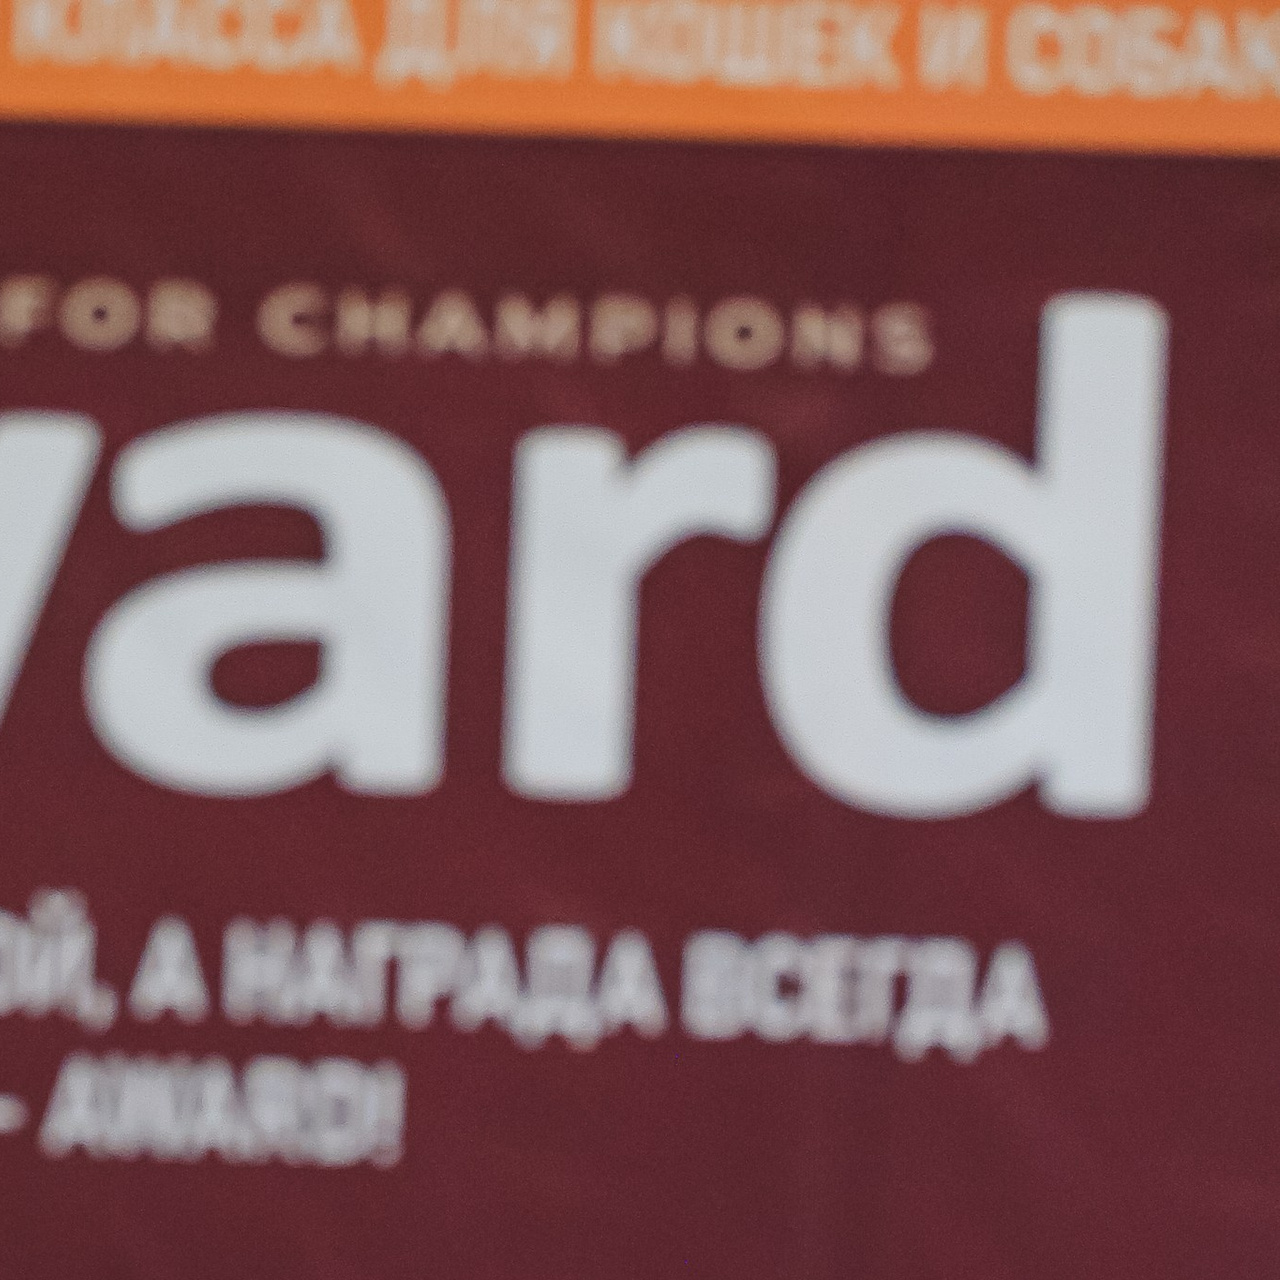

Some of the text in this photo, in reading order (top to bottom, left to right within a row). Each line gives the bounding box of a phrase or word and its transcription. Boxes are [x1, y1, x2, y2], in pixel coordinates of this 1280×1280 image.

[591, 0, 907, 90] КОШЕК
[919, 3, 987, 95] И
[256, 280, 936, 376] CHAMPIONS
[129, 914, 210, 1023] А
[221, 917, 669, 1053] НАГРАДА
[680, 928, 1050, 1061] ВСЕГДА
[38, 1049, 406, 1168] AWARD!
